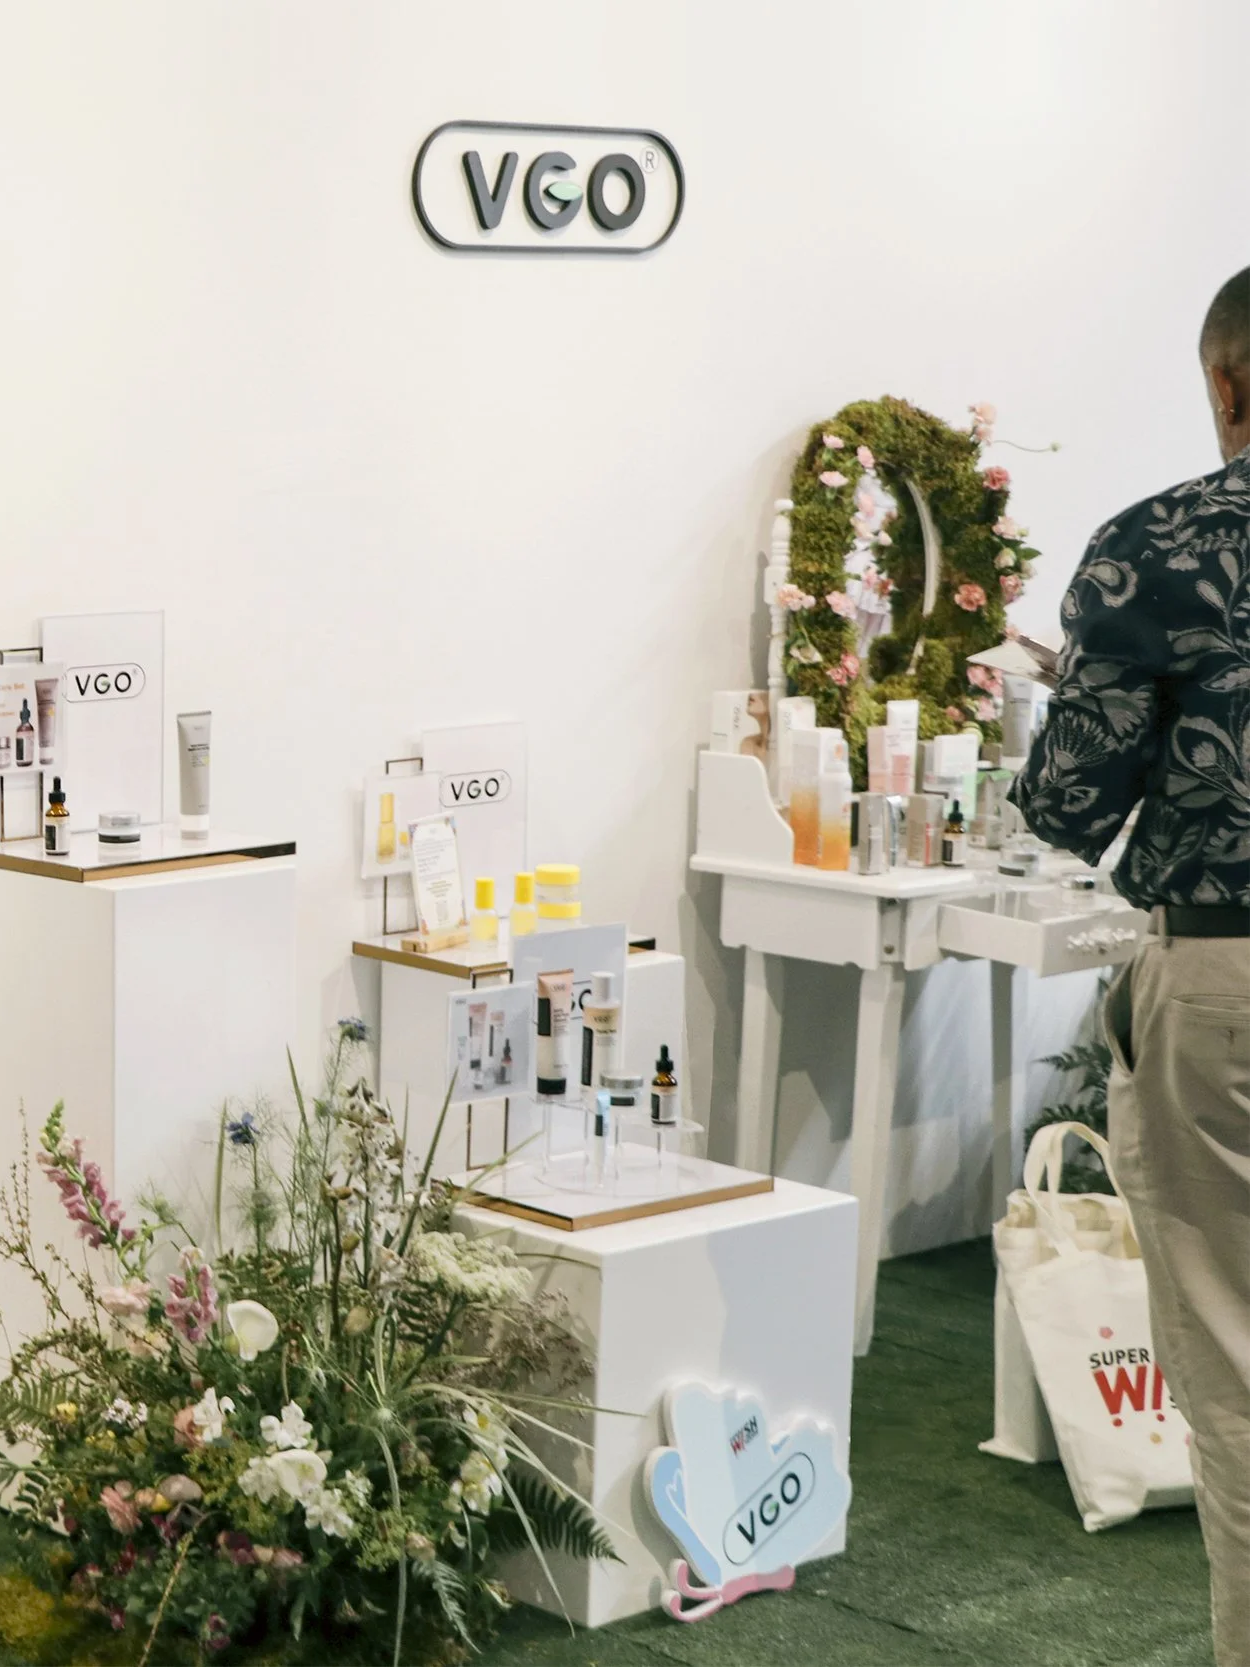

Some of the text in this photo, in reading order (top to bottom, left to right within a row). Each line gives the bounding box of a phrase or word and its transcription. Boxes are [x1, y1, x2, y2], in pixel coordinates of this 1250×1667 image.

[75, 671, 132, 696] VGO
[451, 777, 500, 801] VGO
[1089, 1348, 1150, 1369] SUPER
[736, 1471, 801, 1545] VGO
